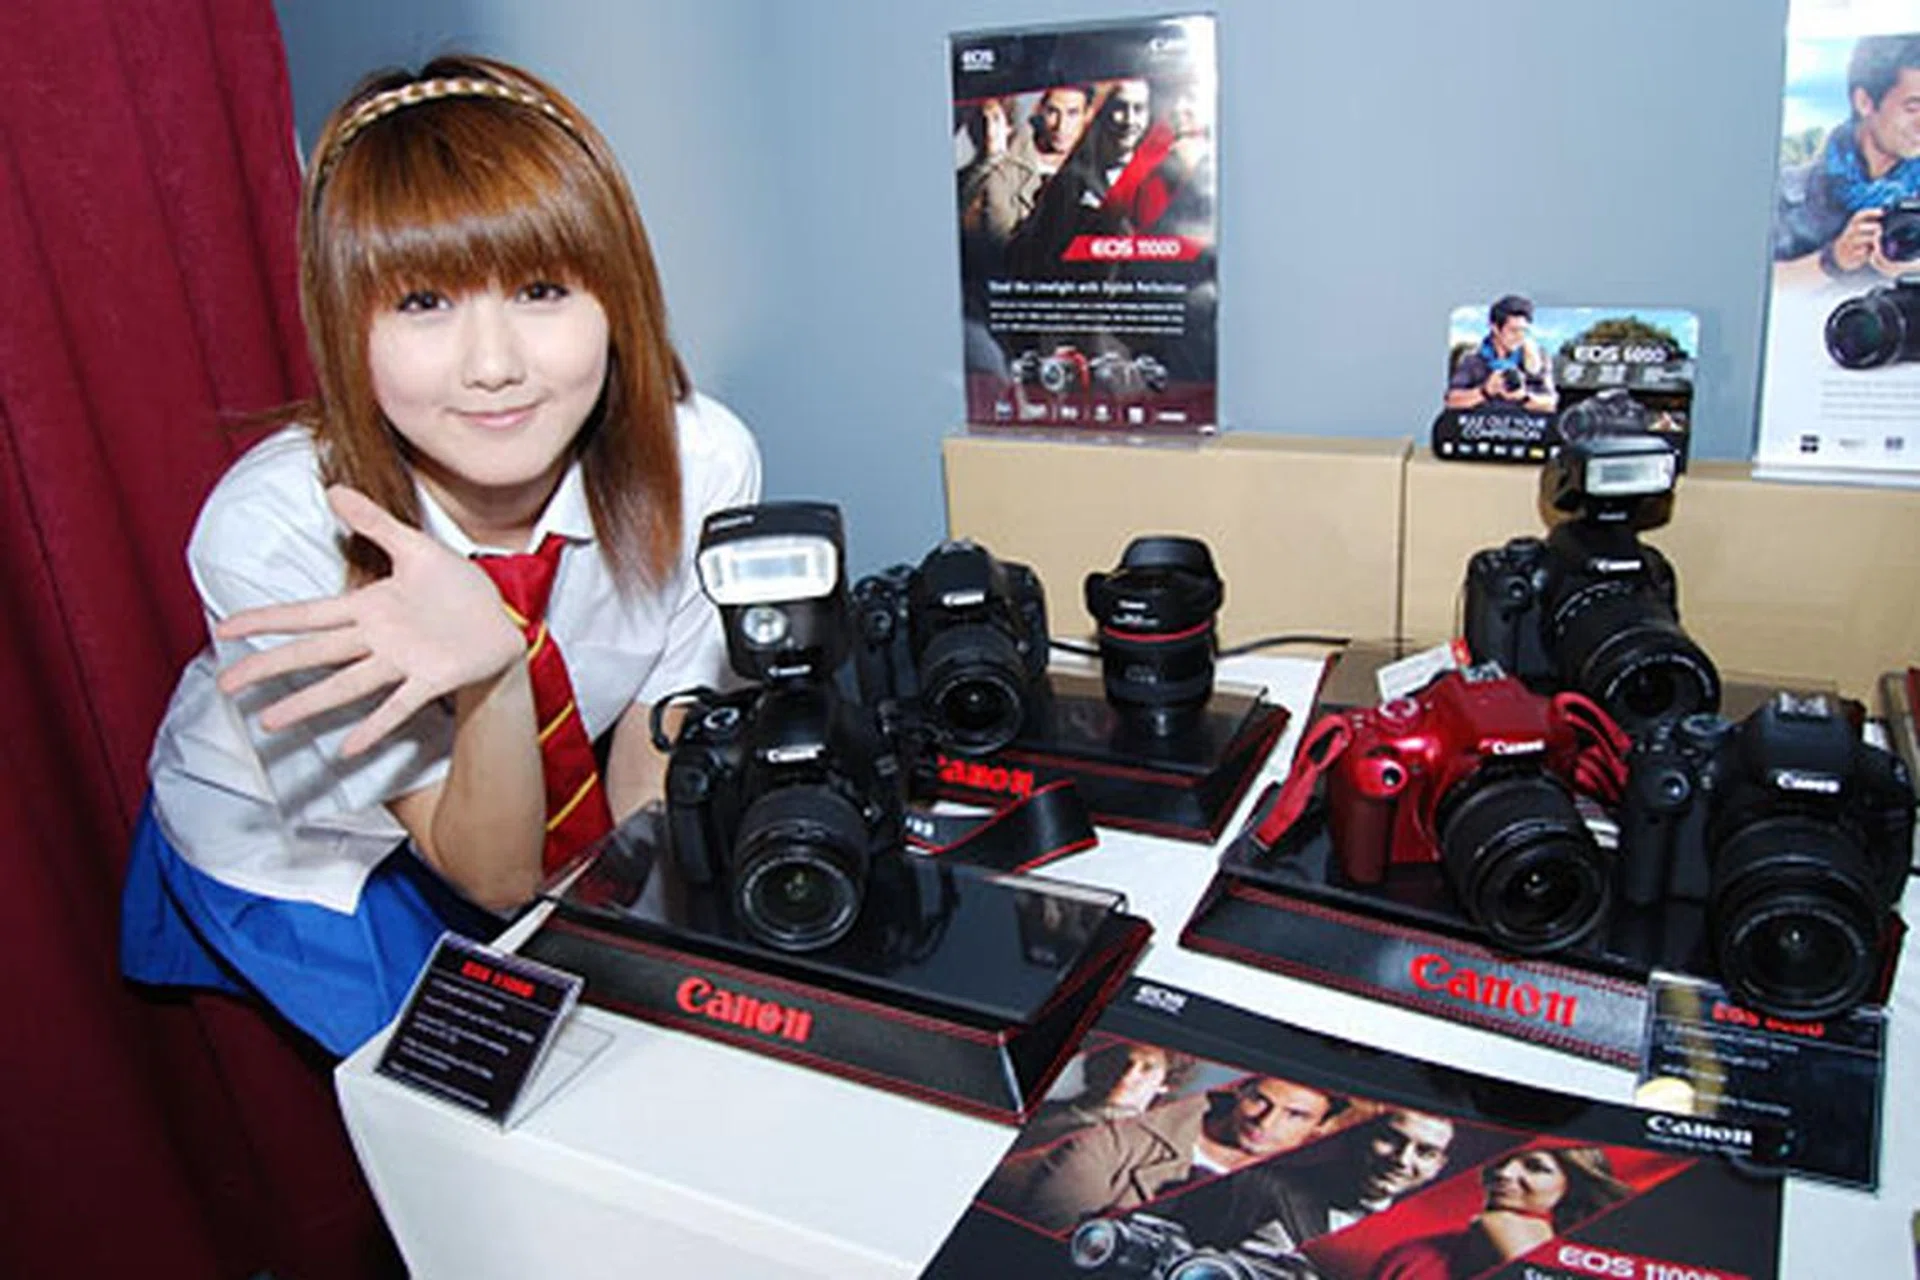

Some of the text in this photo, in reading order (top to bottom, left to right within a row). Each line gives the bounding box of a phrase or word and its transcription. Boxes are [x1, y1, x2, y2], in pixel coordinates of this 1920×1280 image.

[1091, 239, 1132, 256] EOS
[1575, 346, 1619, 363] EOS
[1409, 952, 1577, 1028] Canon
[676, 975, 814, 1044] Canon
[1646, 1115, 1753, 1146] Canon
[1558, 1245, 1635, 1278] EOS
